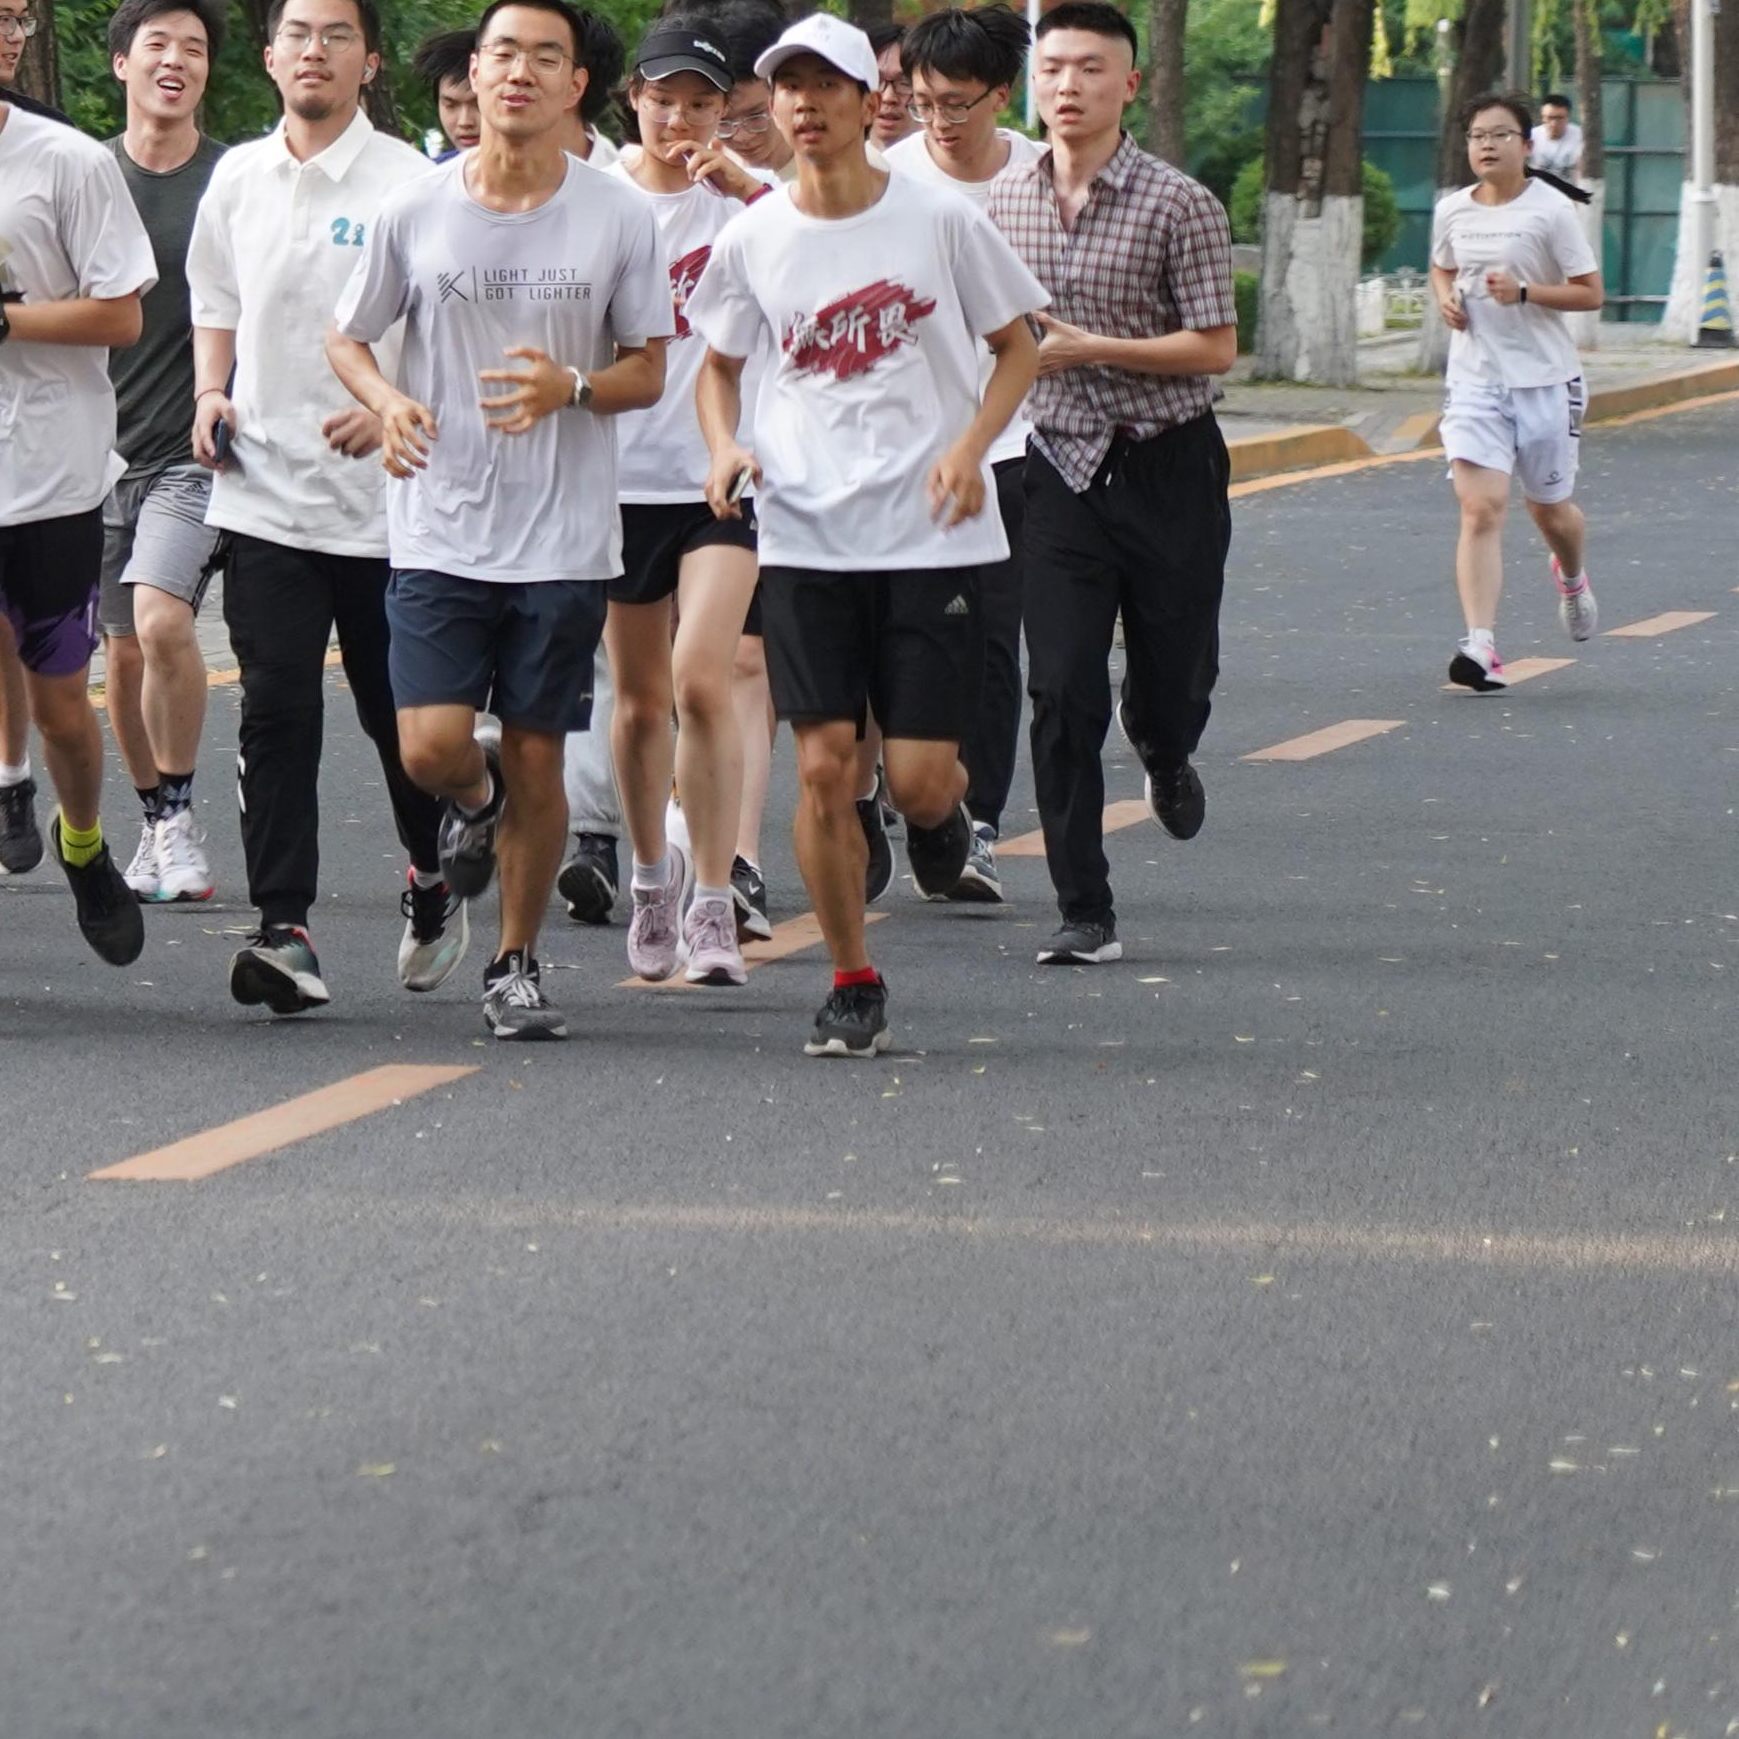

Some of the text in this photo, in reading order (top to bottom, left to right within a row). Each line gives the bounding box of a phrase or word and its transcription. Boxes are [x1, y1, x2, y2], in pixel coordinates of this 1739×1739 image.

[484, 268, 578, 283] LIGHT JUST
[485, 286, 592, 301] GOT LIGHTER
